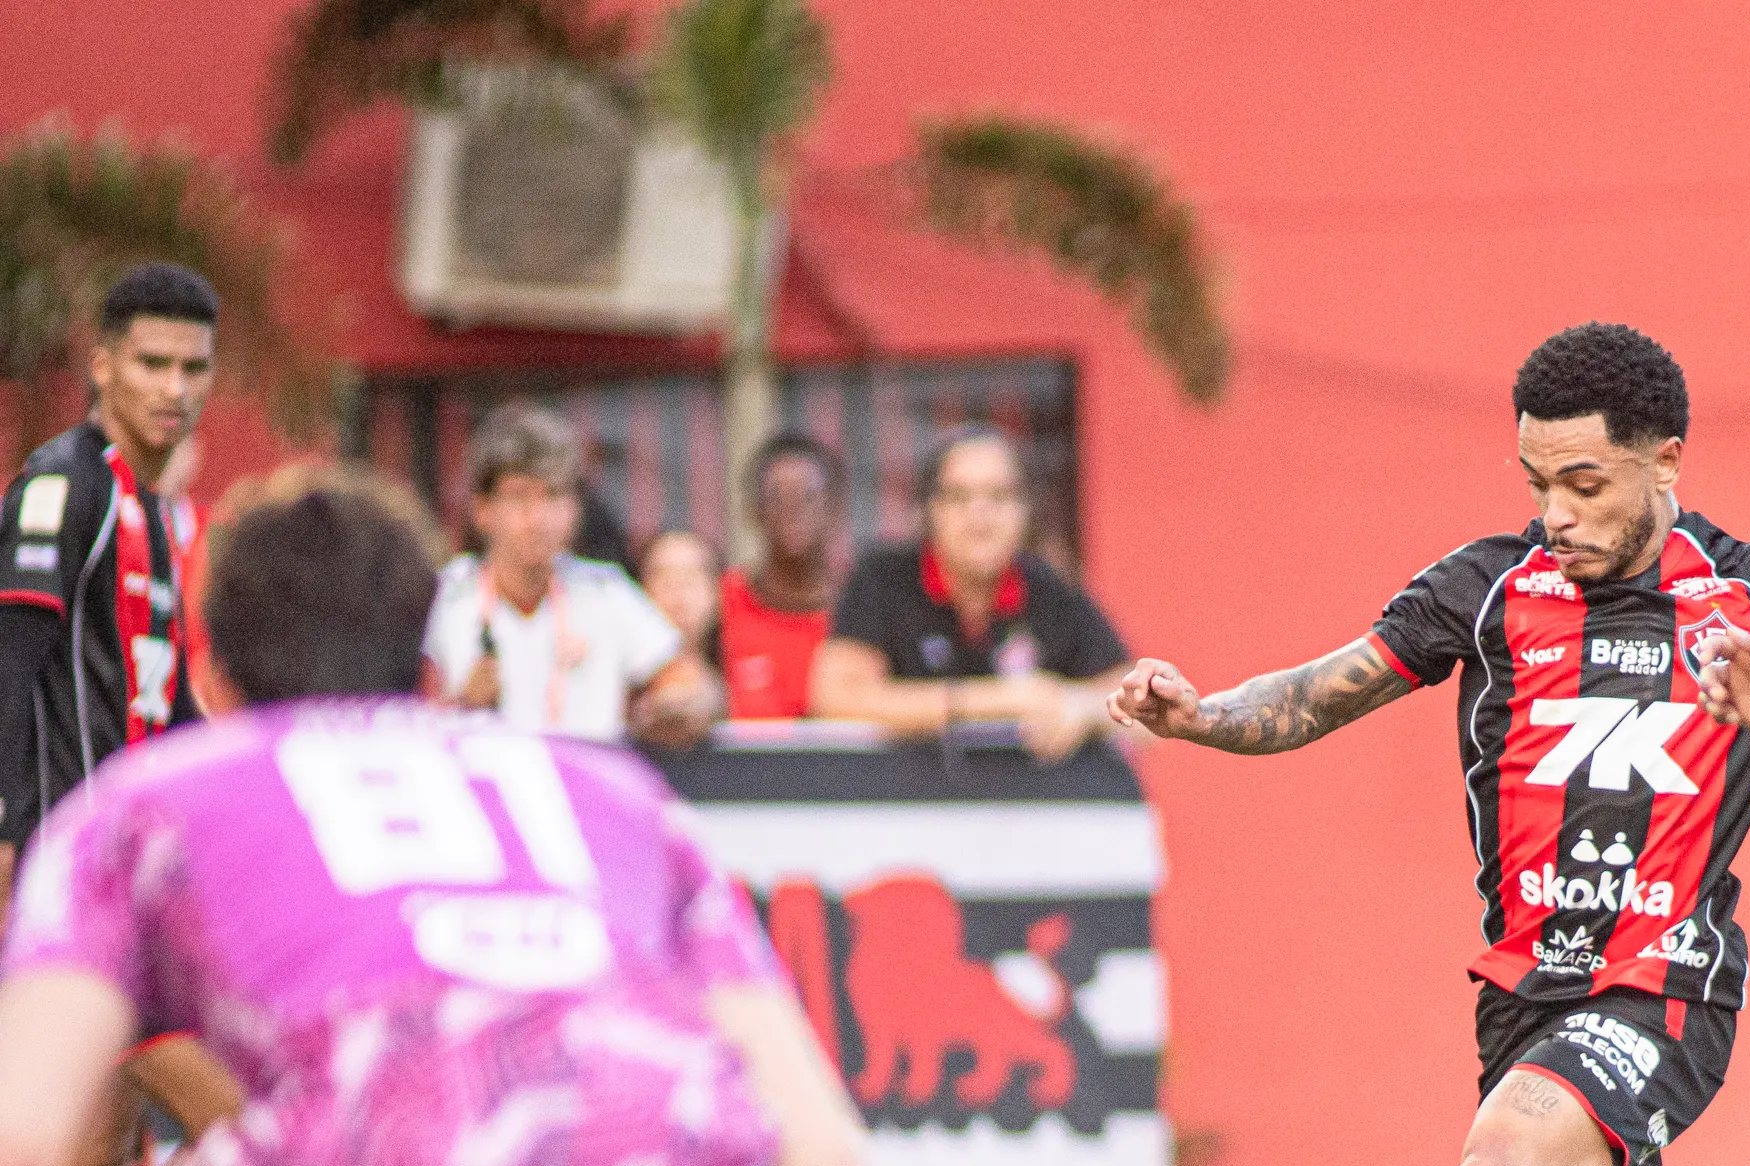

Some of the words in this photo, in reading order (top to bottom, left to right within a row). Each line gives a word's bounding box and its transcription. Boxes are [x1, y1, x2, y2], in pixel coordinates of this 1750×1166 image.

[1520, 646, 1566, 667] VOLT
[1525, 697, 1700, 795] 7K
[274, 730, 602, 896] 81
[1518, 861, 1675, 918] skokka
[1579, 1052, 1617, 1092] VOLT
